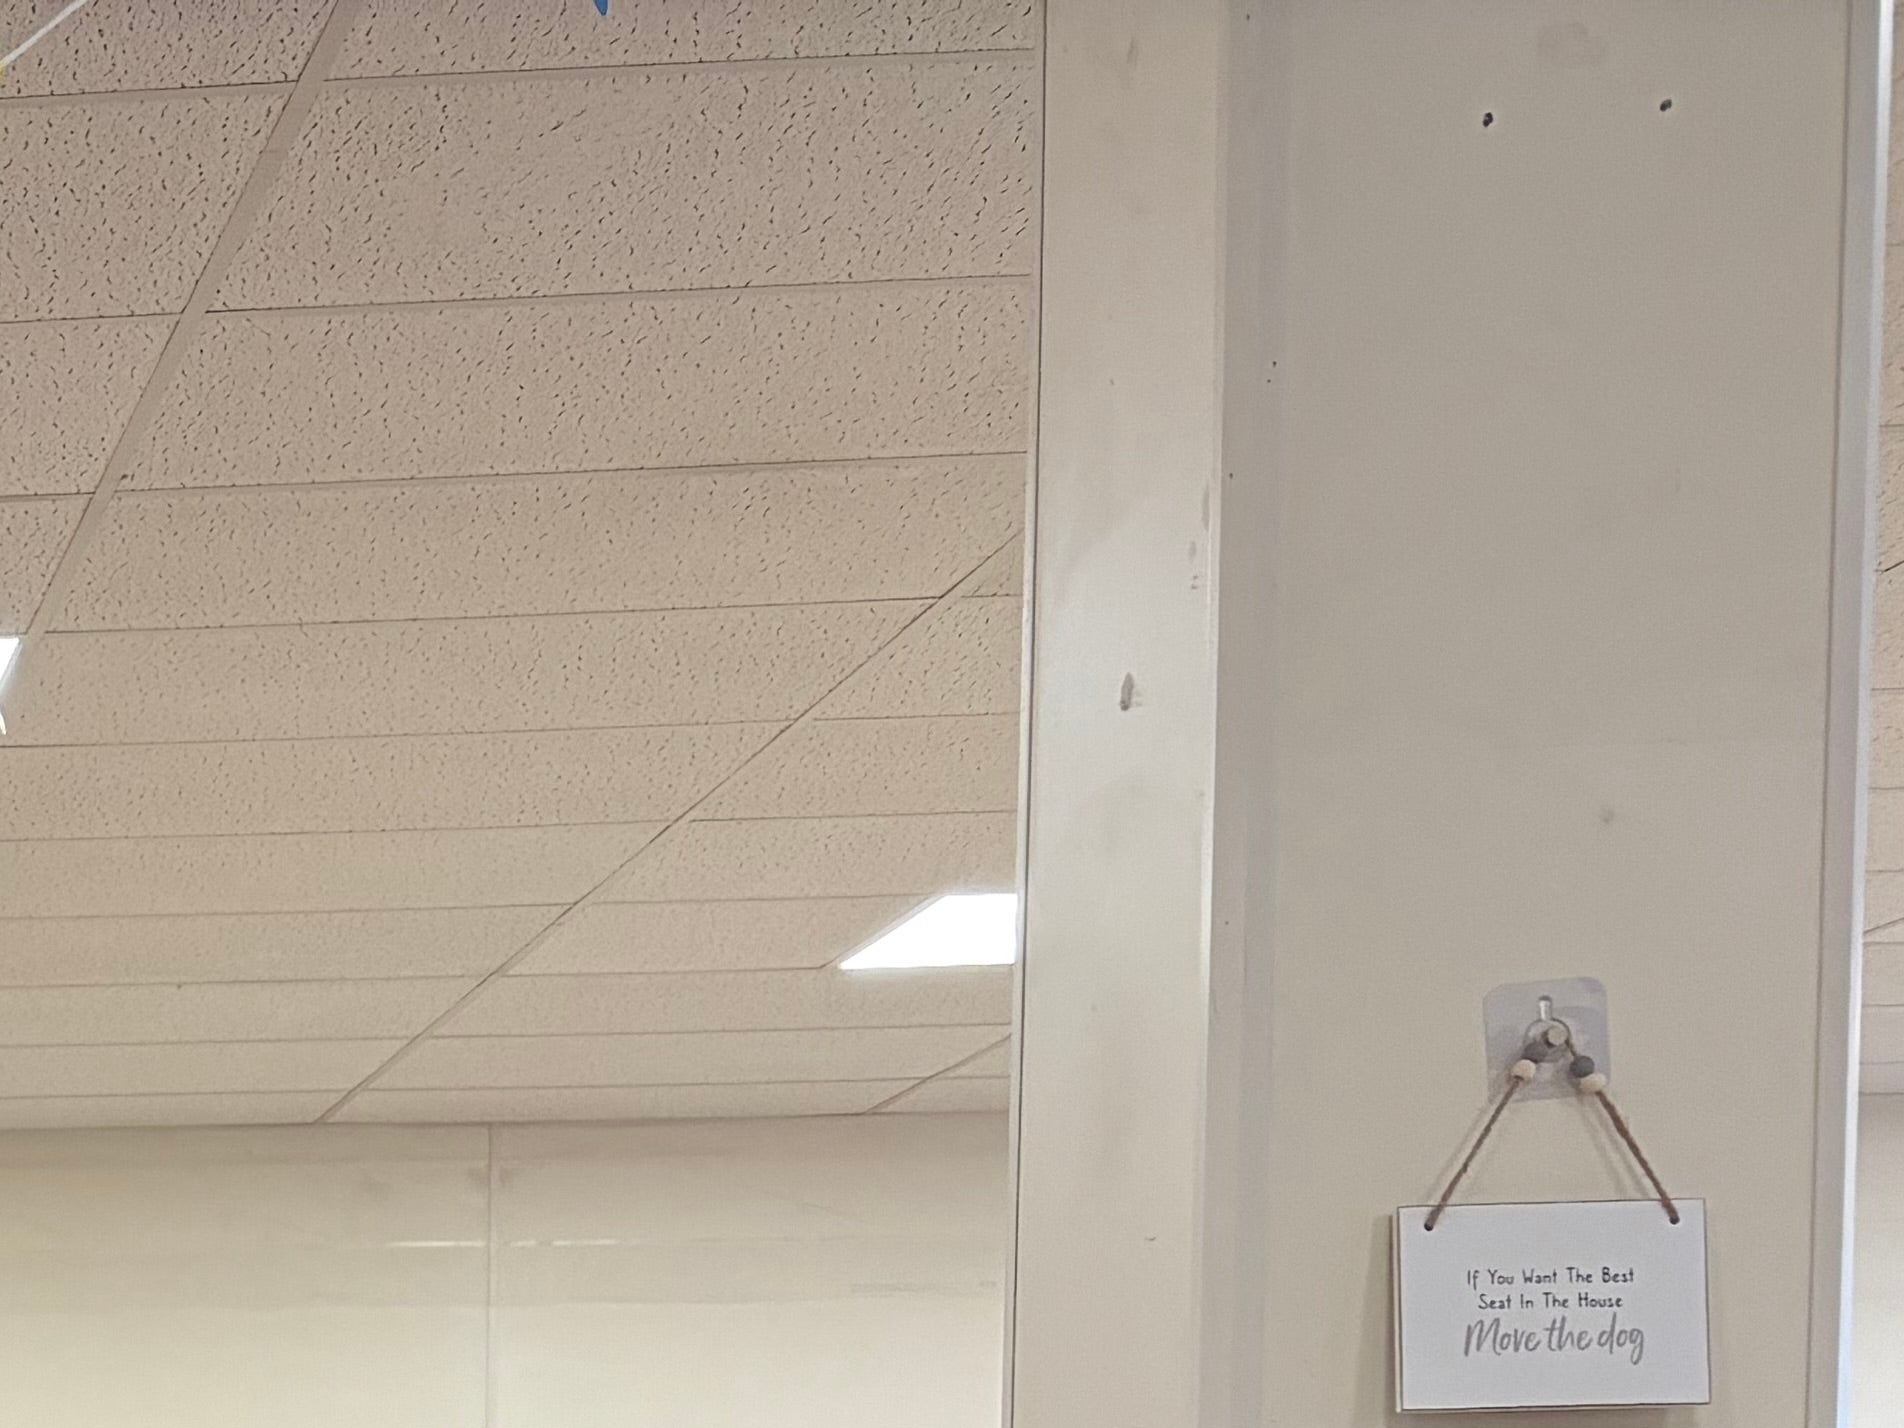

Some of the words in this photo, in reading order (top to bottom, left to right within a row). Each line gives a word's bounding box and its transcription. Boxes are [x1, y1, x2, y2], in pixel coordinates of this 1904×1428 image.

[1467, 1270, 1480, 1290] If
[1488, 1269, 1514, 1285] You
[1522, 1268, 1557, 1284] Want
[1566, 1267, 1593, 1284] The
[1602, 1266, 1634, 1283] Best
[1478, 1293, 1512, 1310] Seat
[1520, 1293, 1534, 1309] In
[1542, 1292, 1569, 1309] The
[1578, 1292, 1623, 1308] House
[1464, 1317, 1541, 1357] Move
[1543, 1315, 1593, 1351] the
[1597, 1311, 1645, 1366] dog
